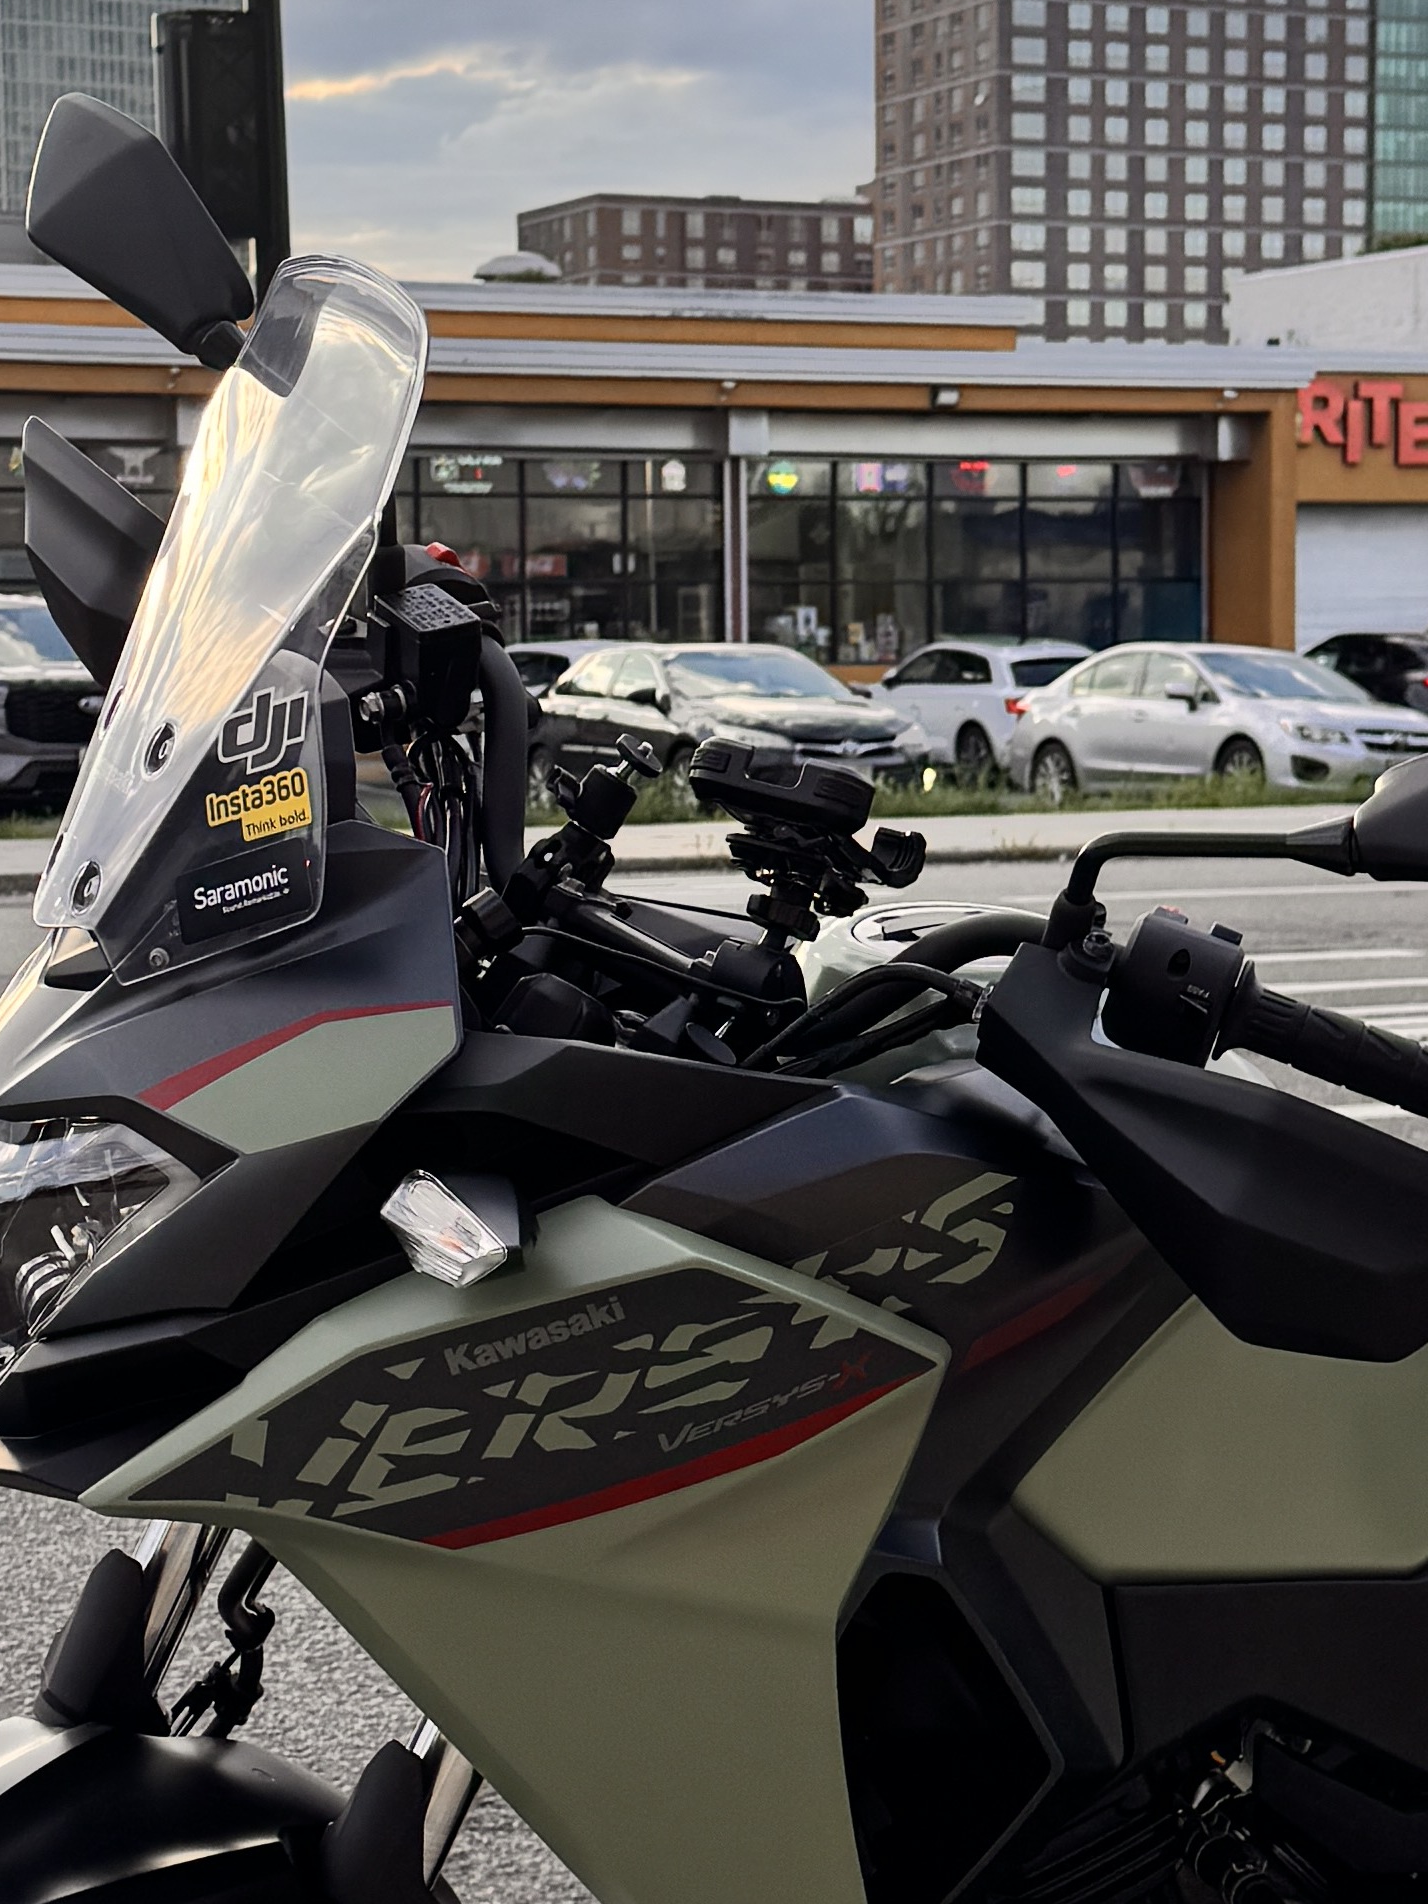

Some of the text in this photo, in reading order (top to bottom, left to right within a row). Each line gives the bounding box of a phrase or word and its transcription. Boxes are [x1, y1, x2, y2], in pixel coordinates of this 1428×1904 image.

[207, 769, 307, 823] Insta360
[245, 818, 277, 838] Think
[193, 864, 289, 910] Saramonic
[444, 1296, 626, 1377] Kawasaki
